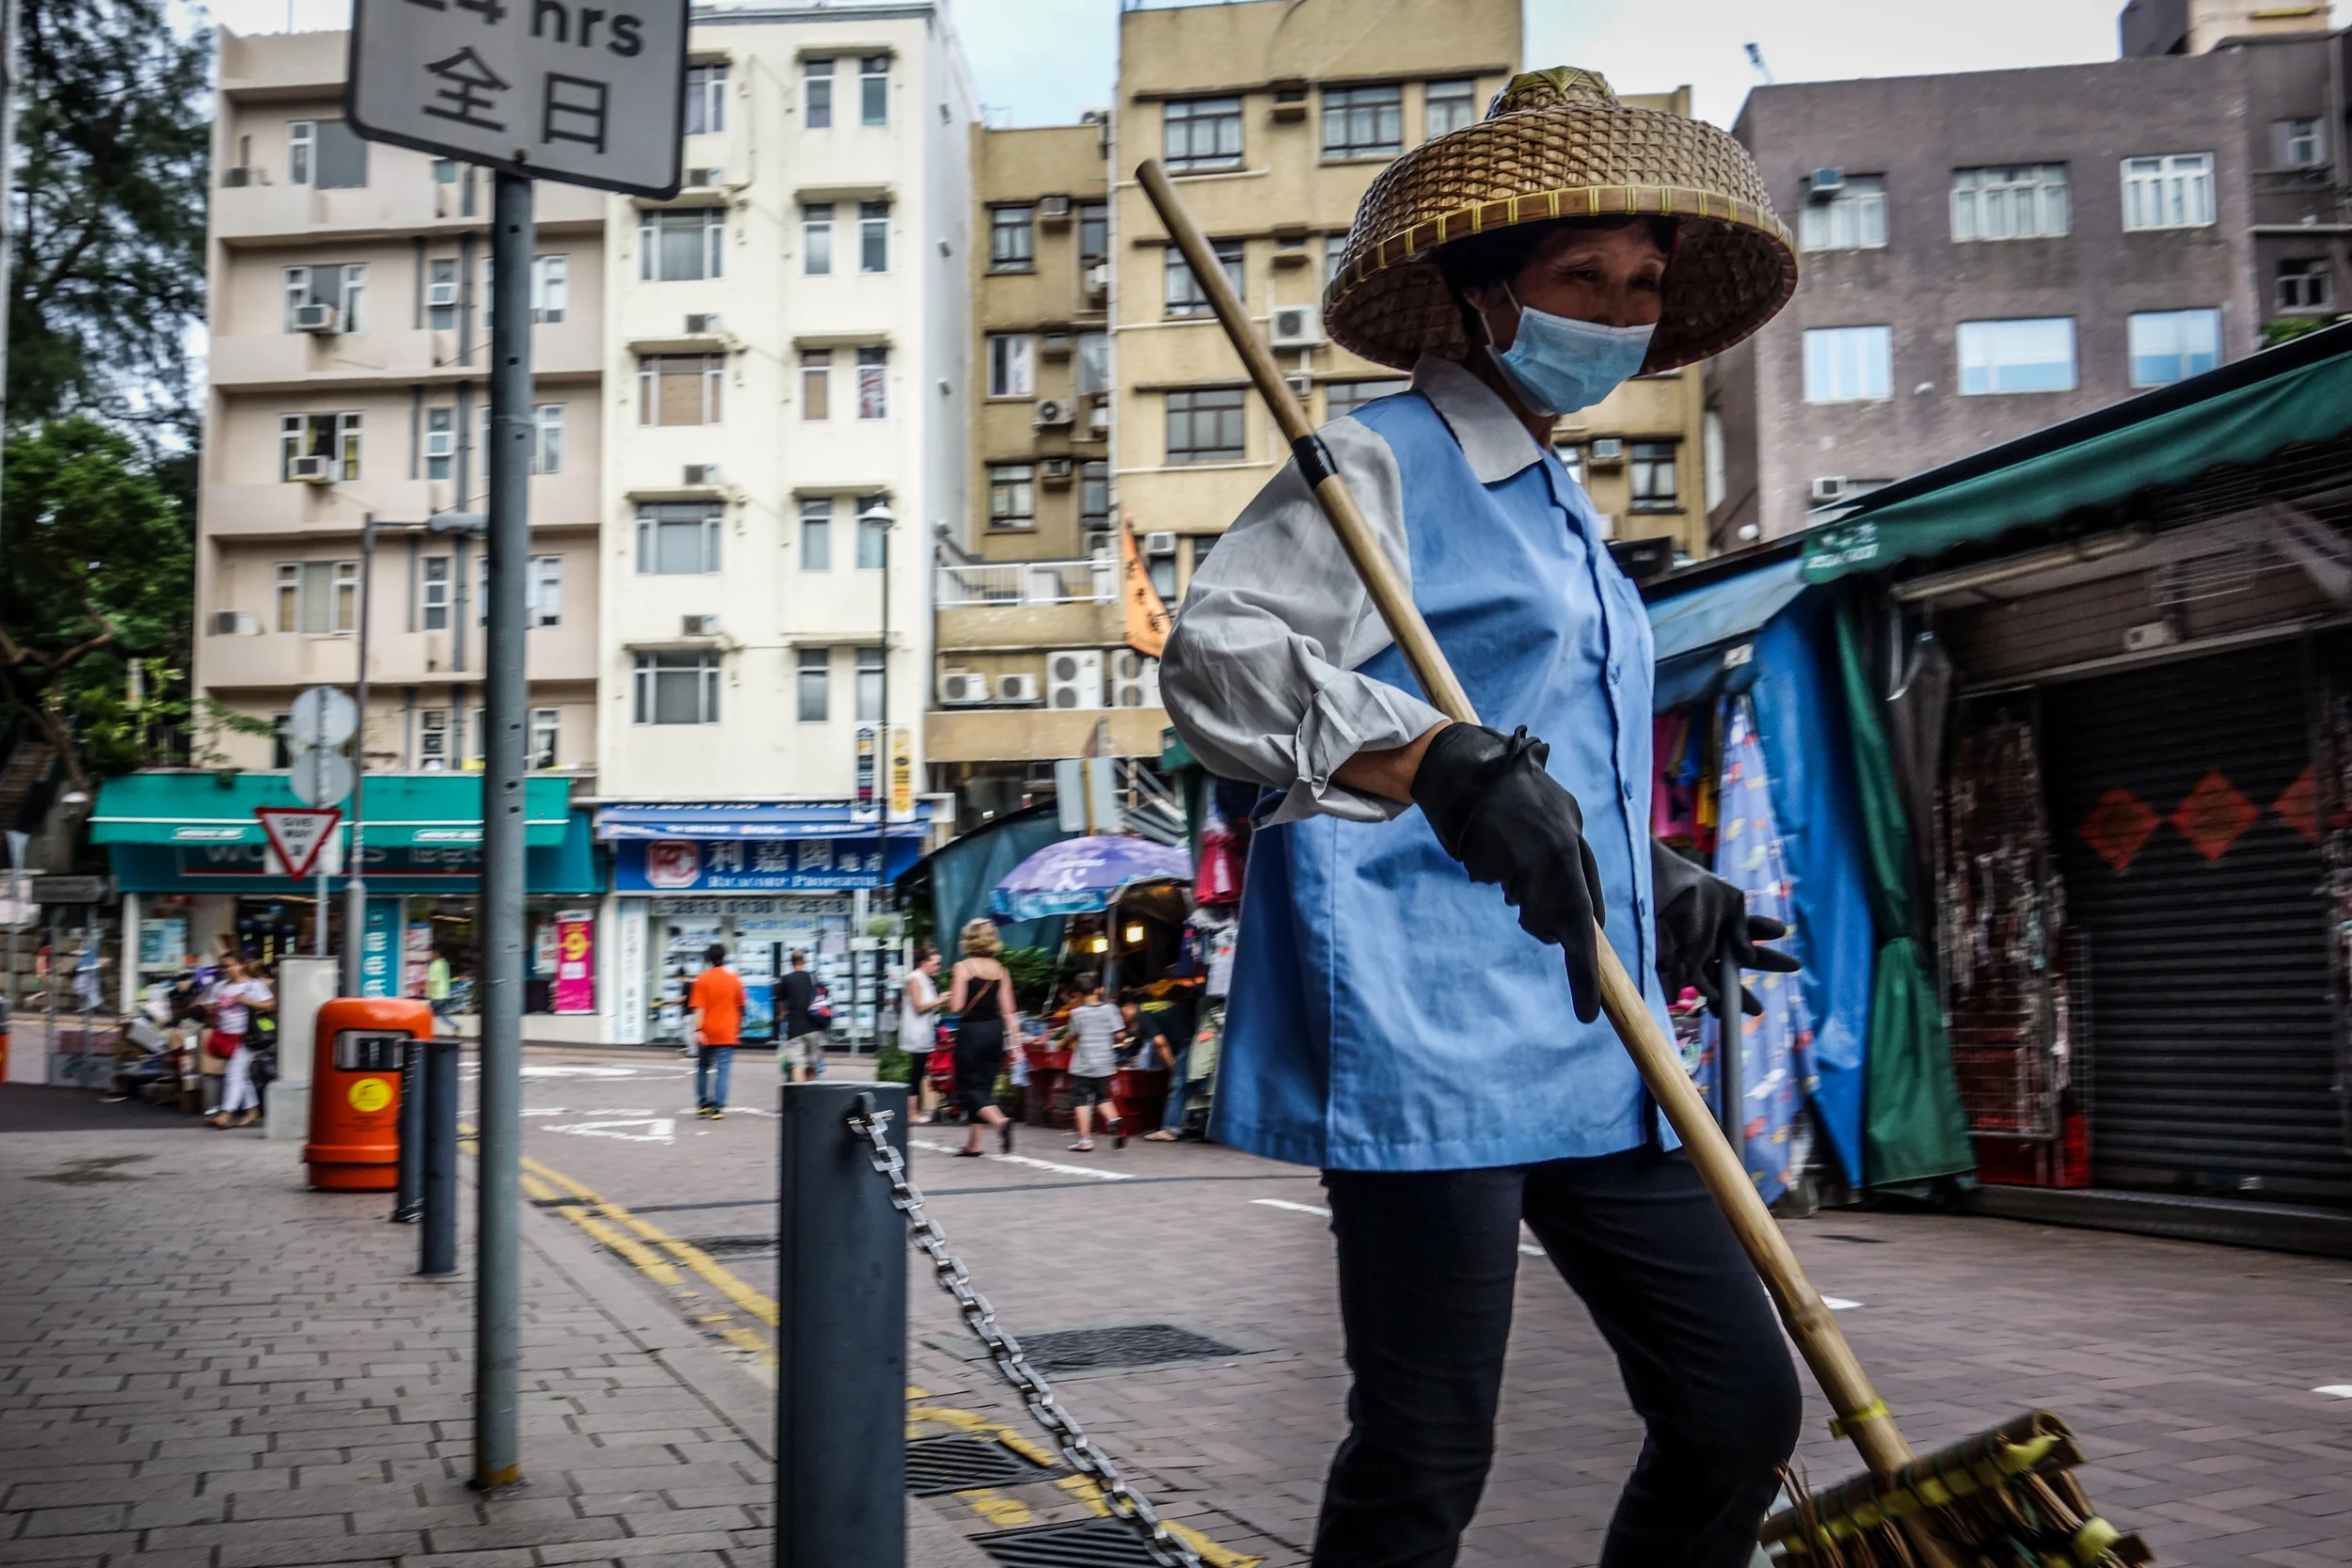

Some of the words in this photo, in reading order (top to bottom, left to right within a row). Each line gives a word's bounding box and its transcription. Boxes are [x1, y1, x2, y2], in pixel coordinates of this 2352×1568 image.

[529, 0, 644, 57] hrs
[421, 45, 610, 155] 全日
[281, 816, 314, 827] GIVE
